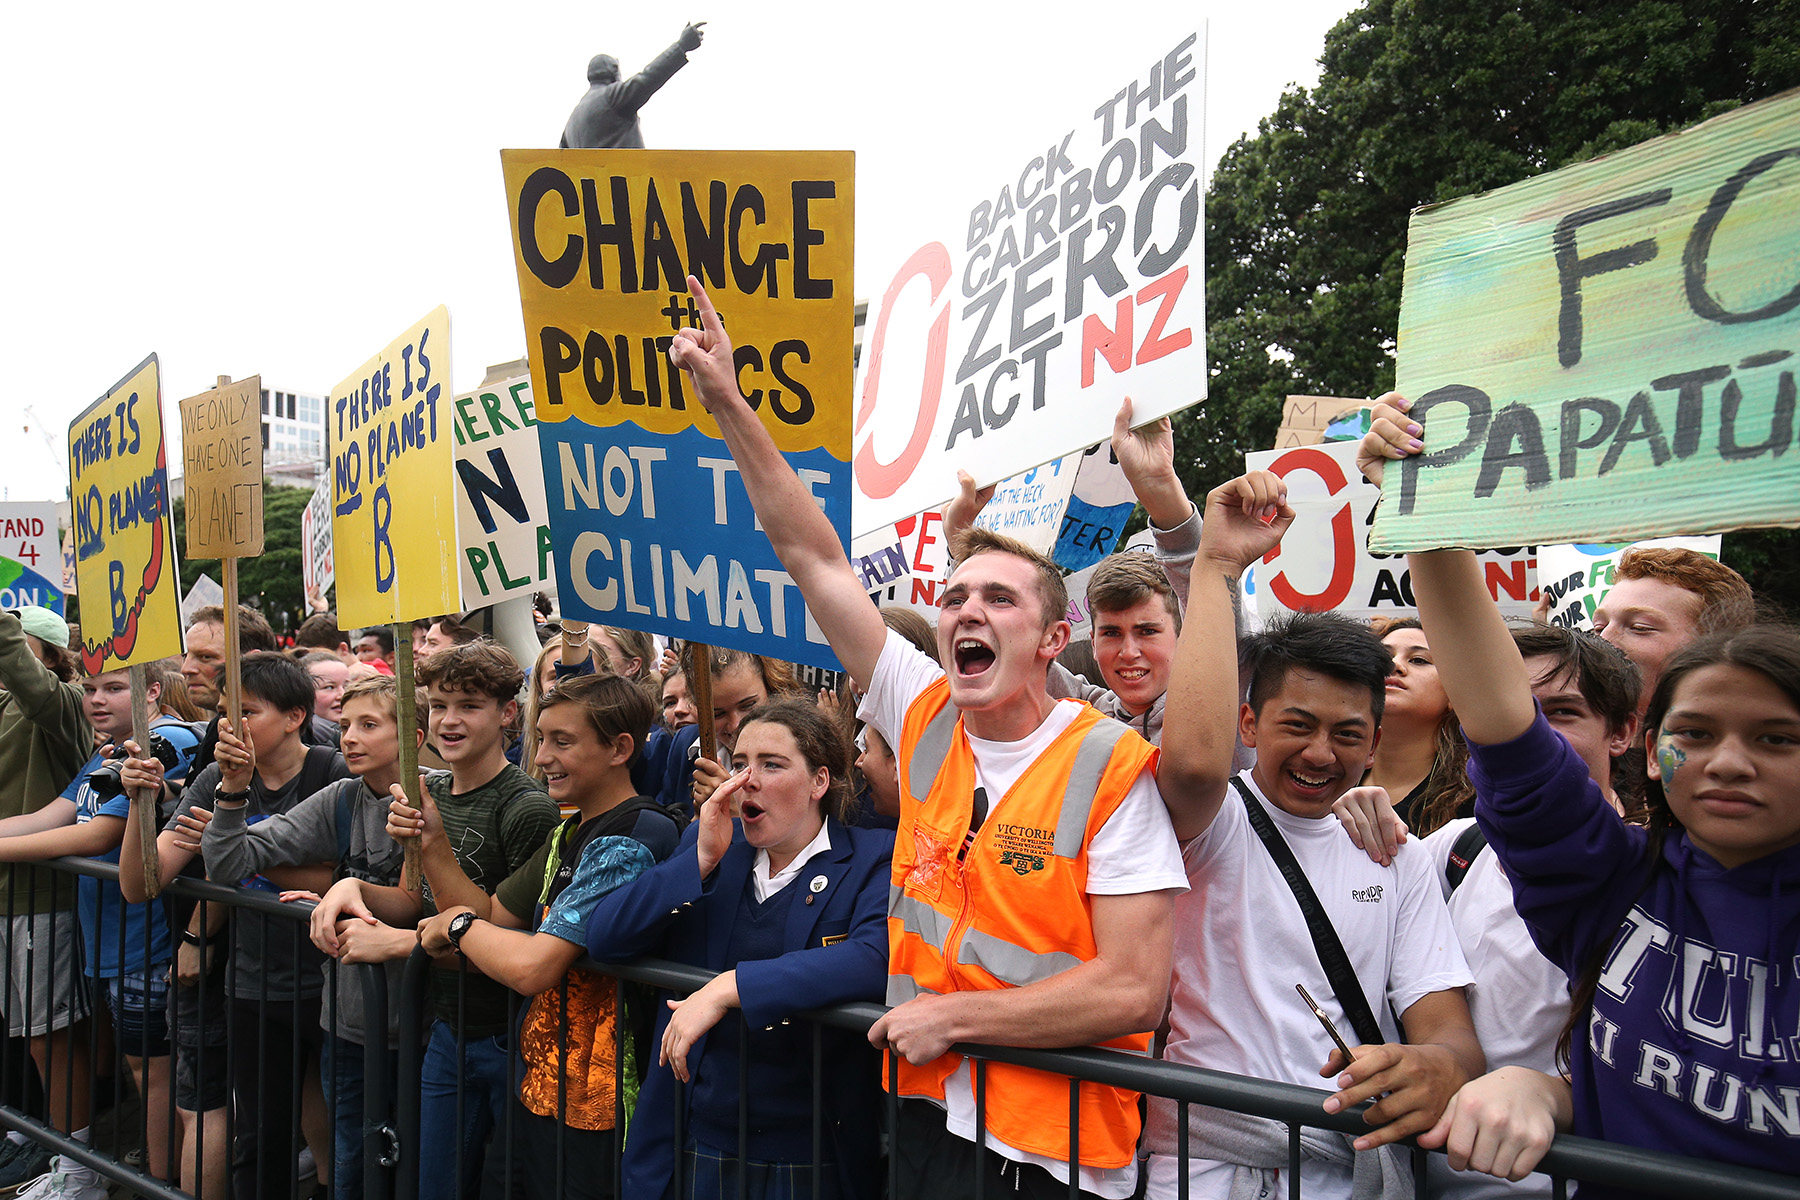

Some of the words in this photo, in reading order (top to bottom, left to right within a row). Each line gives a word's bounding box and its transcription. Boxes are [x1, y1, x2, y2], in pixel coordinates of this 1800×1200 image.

[967, 130, 1075, 251] BACK
[1095, 32, 1197, 146] THE
[518, 166, 836, 299] CHANGE
[962, 94, 1187, 298] CARBON
[955, 162, 1199, 385] ZERO
[336, 362, 391, 441] THERE
[402, 328, 429, 401] IS
[540, 326, 815, 425] POLITCS
[945, 332, 1063, 451] ACT
[1081, 265, 1193, 389] NZ
[73, 413, 111, 481] THERE
[116, 392, 139, 456] IS
[184, 404, 205, 435] WE
[208, 393, 249, 431] ONLY
[188, 443, 214, 474] HAVE
[219, 436, 251, 467] ONE
[336, 441, 361, 500] NO
[367, 383, 441, 485] PLANET
[453, 382, 538, 446] ERE
[1398, 349, 1800, 515] PAPATŪ
[76, 484, 103, 543] NO
[109, 468, 167, 535] PLANET
[188, 483, 259, 546] PLANET
[558, 441, 667, 518] NOT
[989, 512, 1001, 531] WE
[1004, 507, 1039, 528] WAITING
[1008, 488, 1022, 504] THE
[1022, 483, 1045, 504] HECK
[19, 541, 40, 566] 4
[373, 483, 395, 593] B
[109, 560, 128, 633] B
[998, 824, 1055, 840] VICTORIA
[1633, 1038, 1800, 1137] RUN
